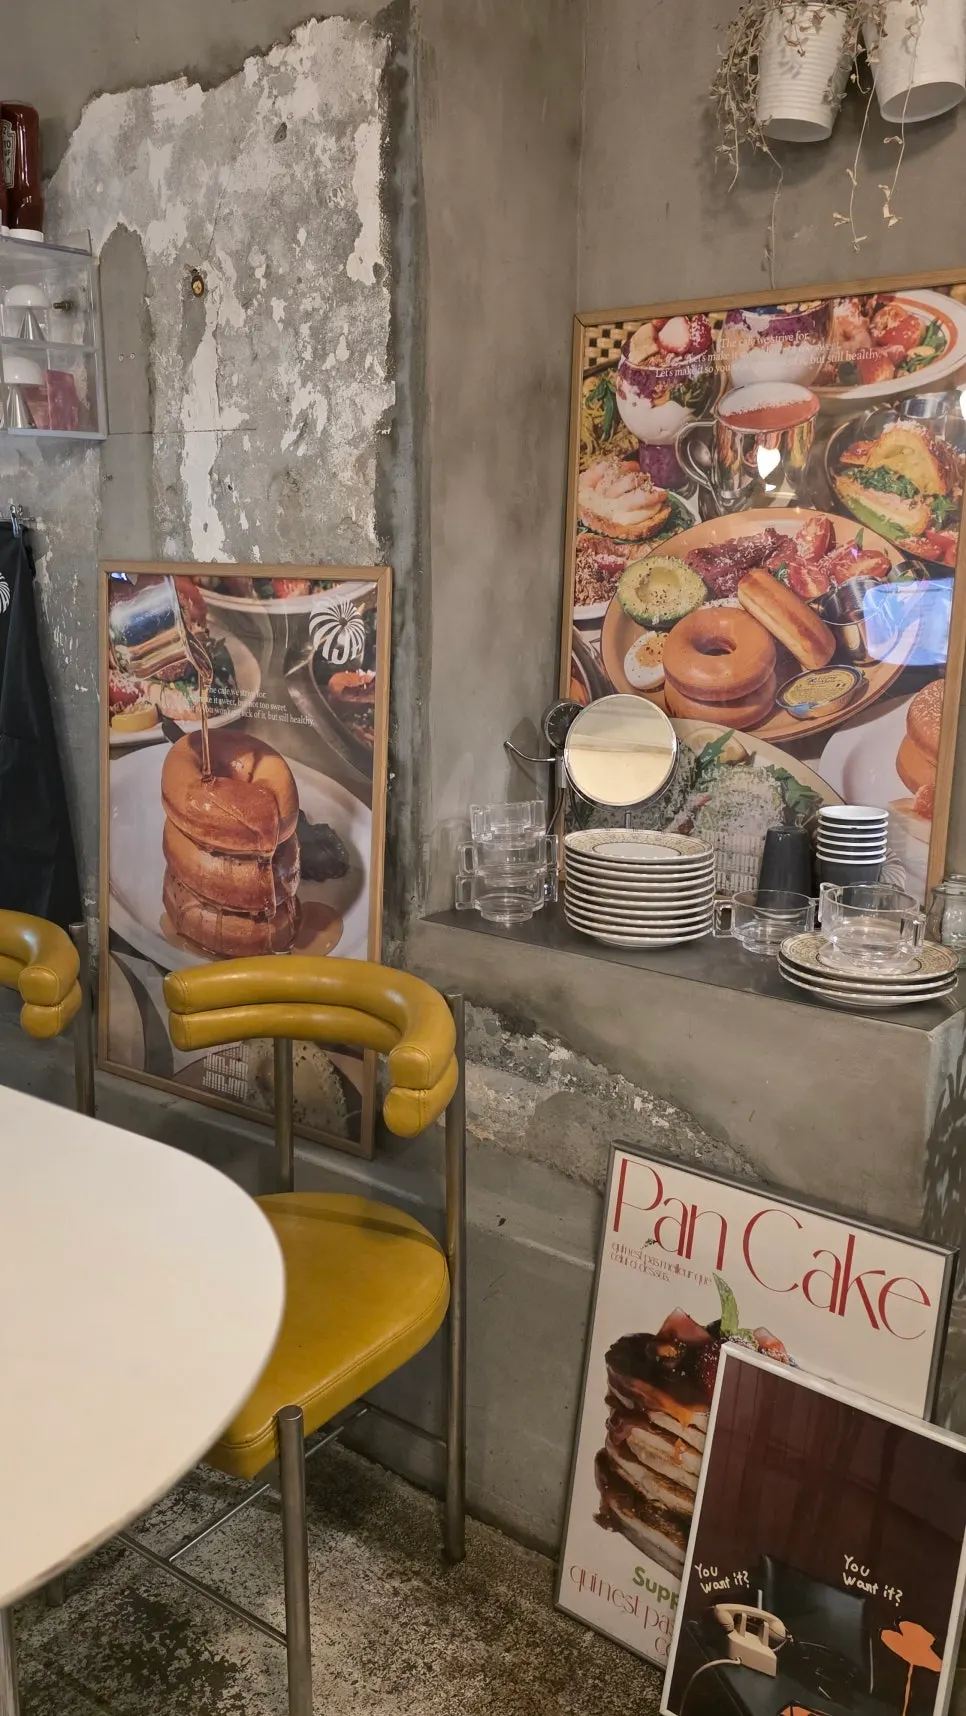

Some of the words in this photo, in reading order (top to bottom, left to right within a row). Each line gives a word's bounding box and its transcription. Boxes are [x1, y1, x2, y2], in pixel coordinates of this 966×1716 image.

[770, 332, 794, 344] strive
[708, 351, 730, 362] make
[655, 367, 673, 378] Let's
[704, 366, 714, 374] so
[715, 365, 731, 376] you
[260, 702, 270, 710] too
[253, 709, 261, 718] of
[267, 711, 278, 721] but
[278, 713, 289, 723] still
[613, 1158, 728, 1271] Pan
[742, 1208, 932, 1340] Cake
[733, 1570, 750, 1589] it?
[883, 1584, 903, 1607] it?
